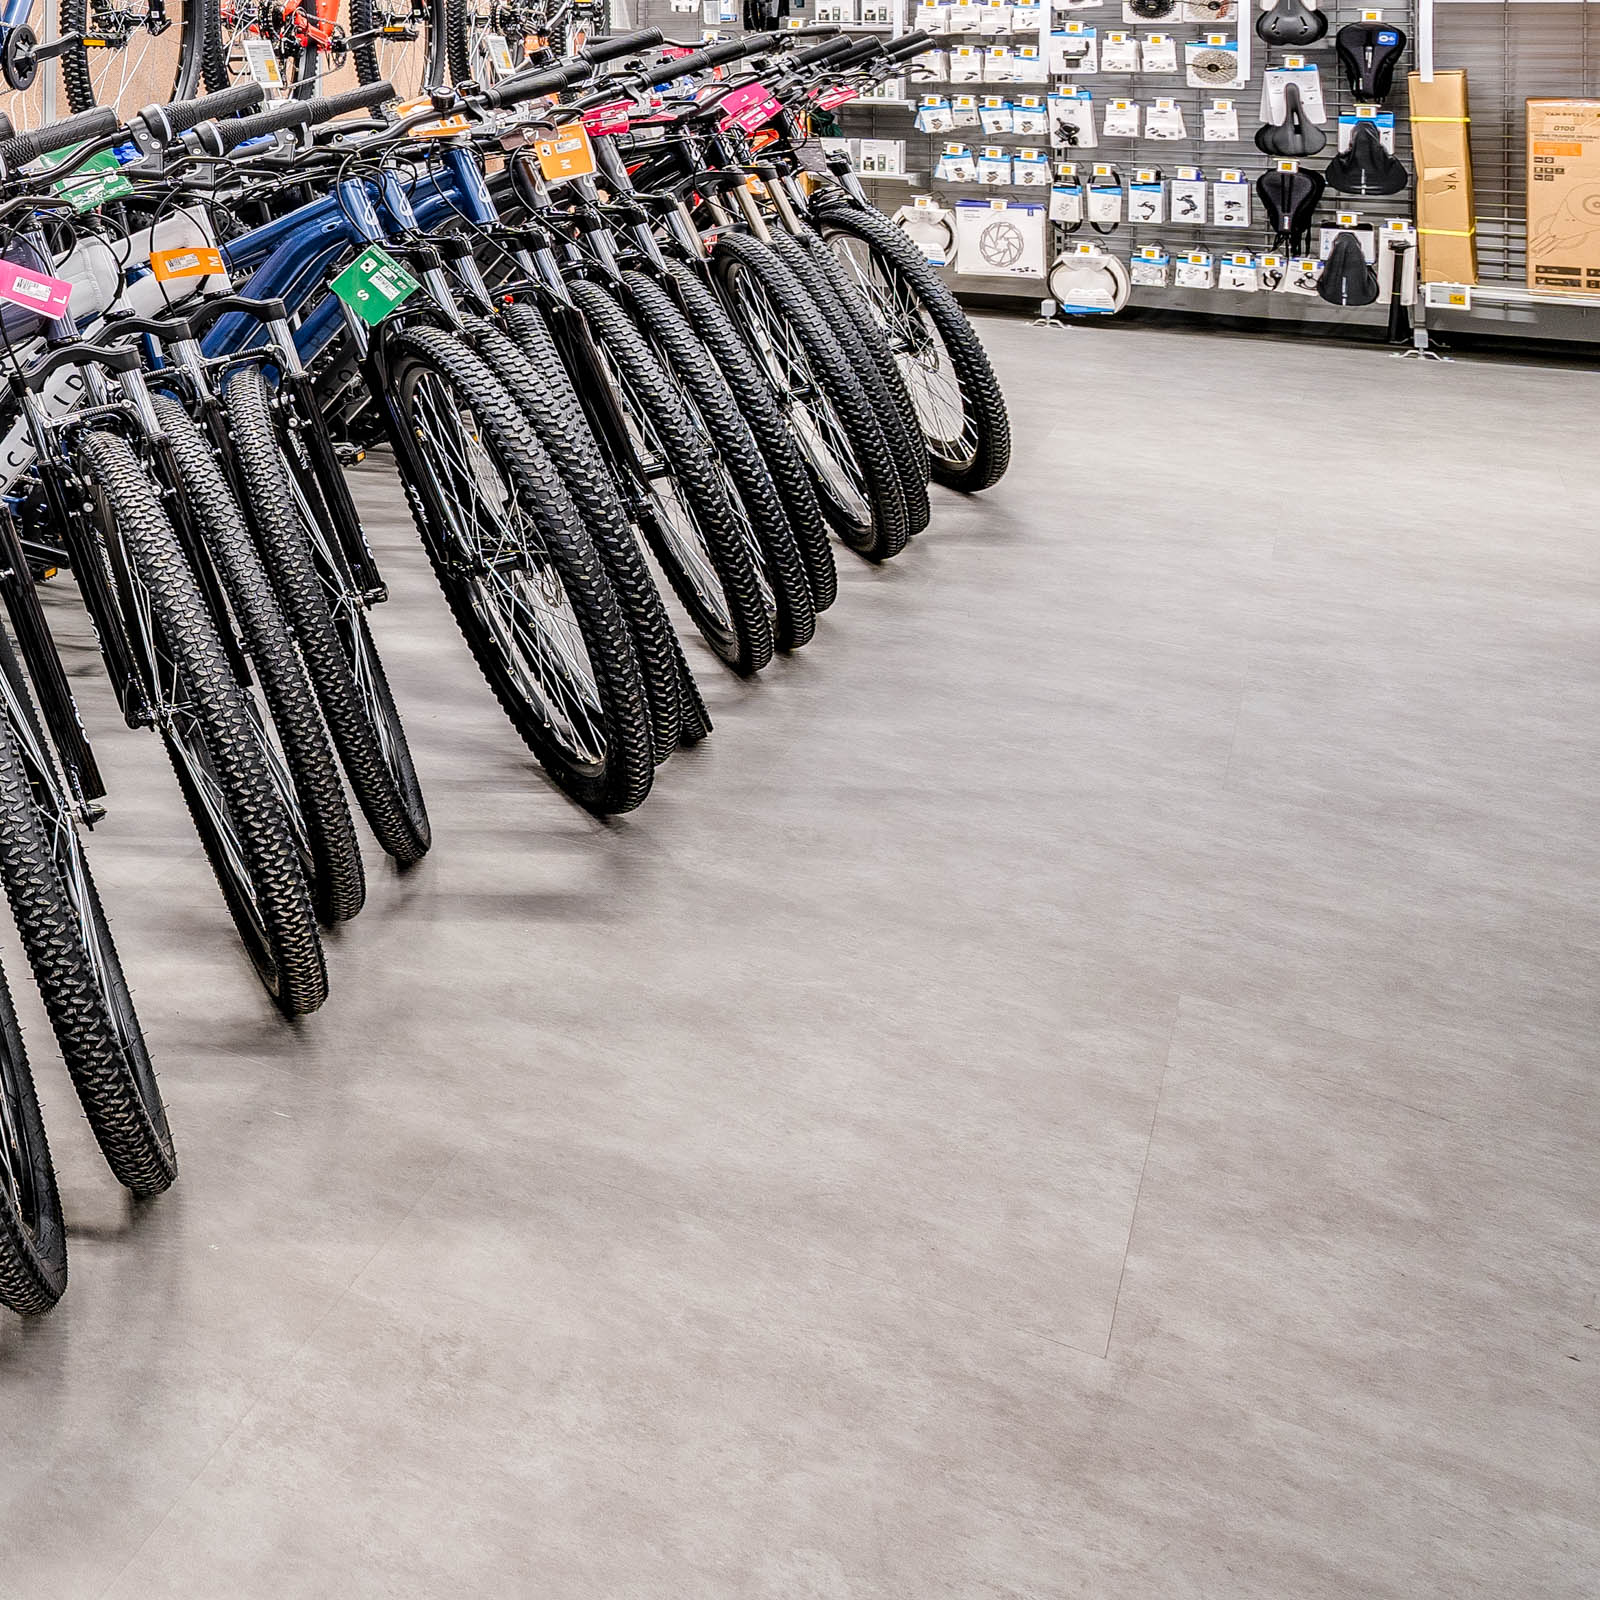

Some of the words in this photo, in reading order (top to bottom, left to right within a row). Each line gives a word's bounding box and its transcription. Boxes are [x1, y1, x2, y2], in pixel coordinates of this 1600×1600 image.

[560, 159, 572, 169] M
[209, 254, 222, 267] M
[52, 294, 68, 305] L
[357, 289, 370, 301] S
